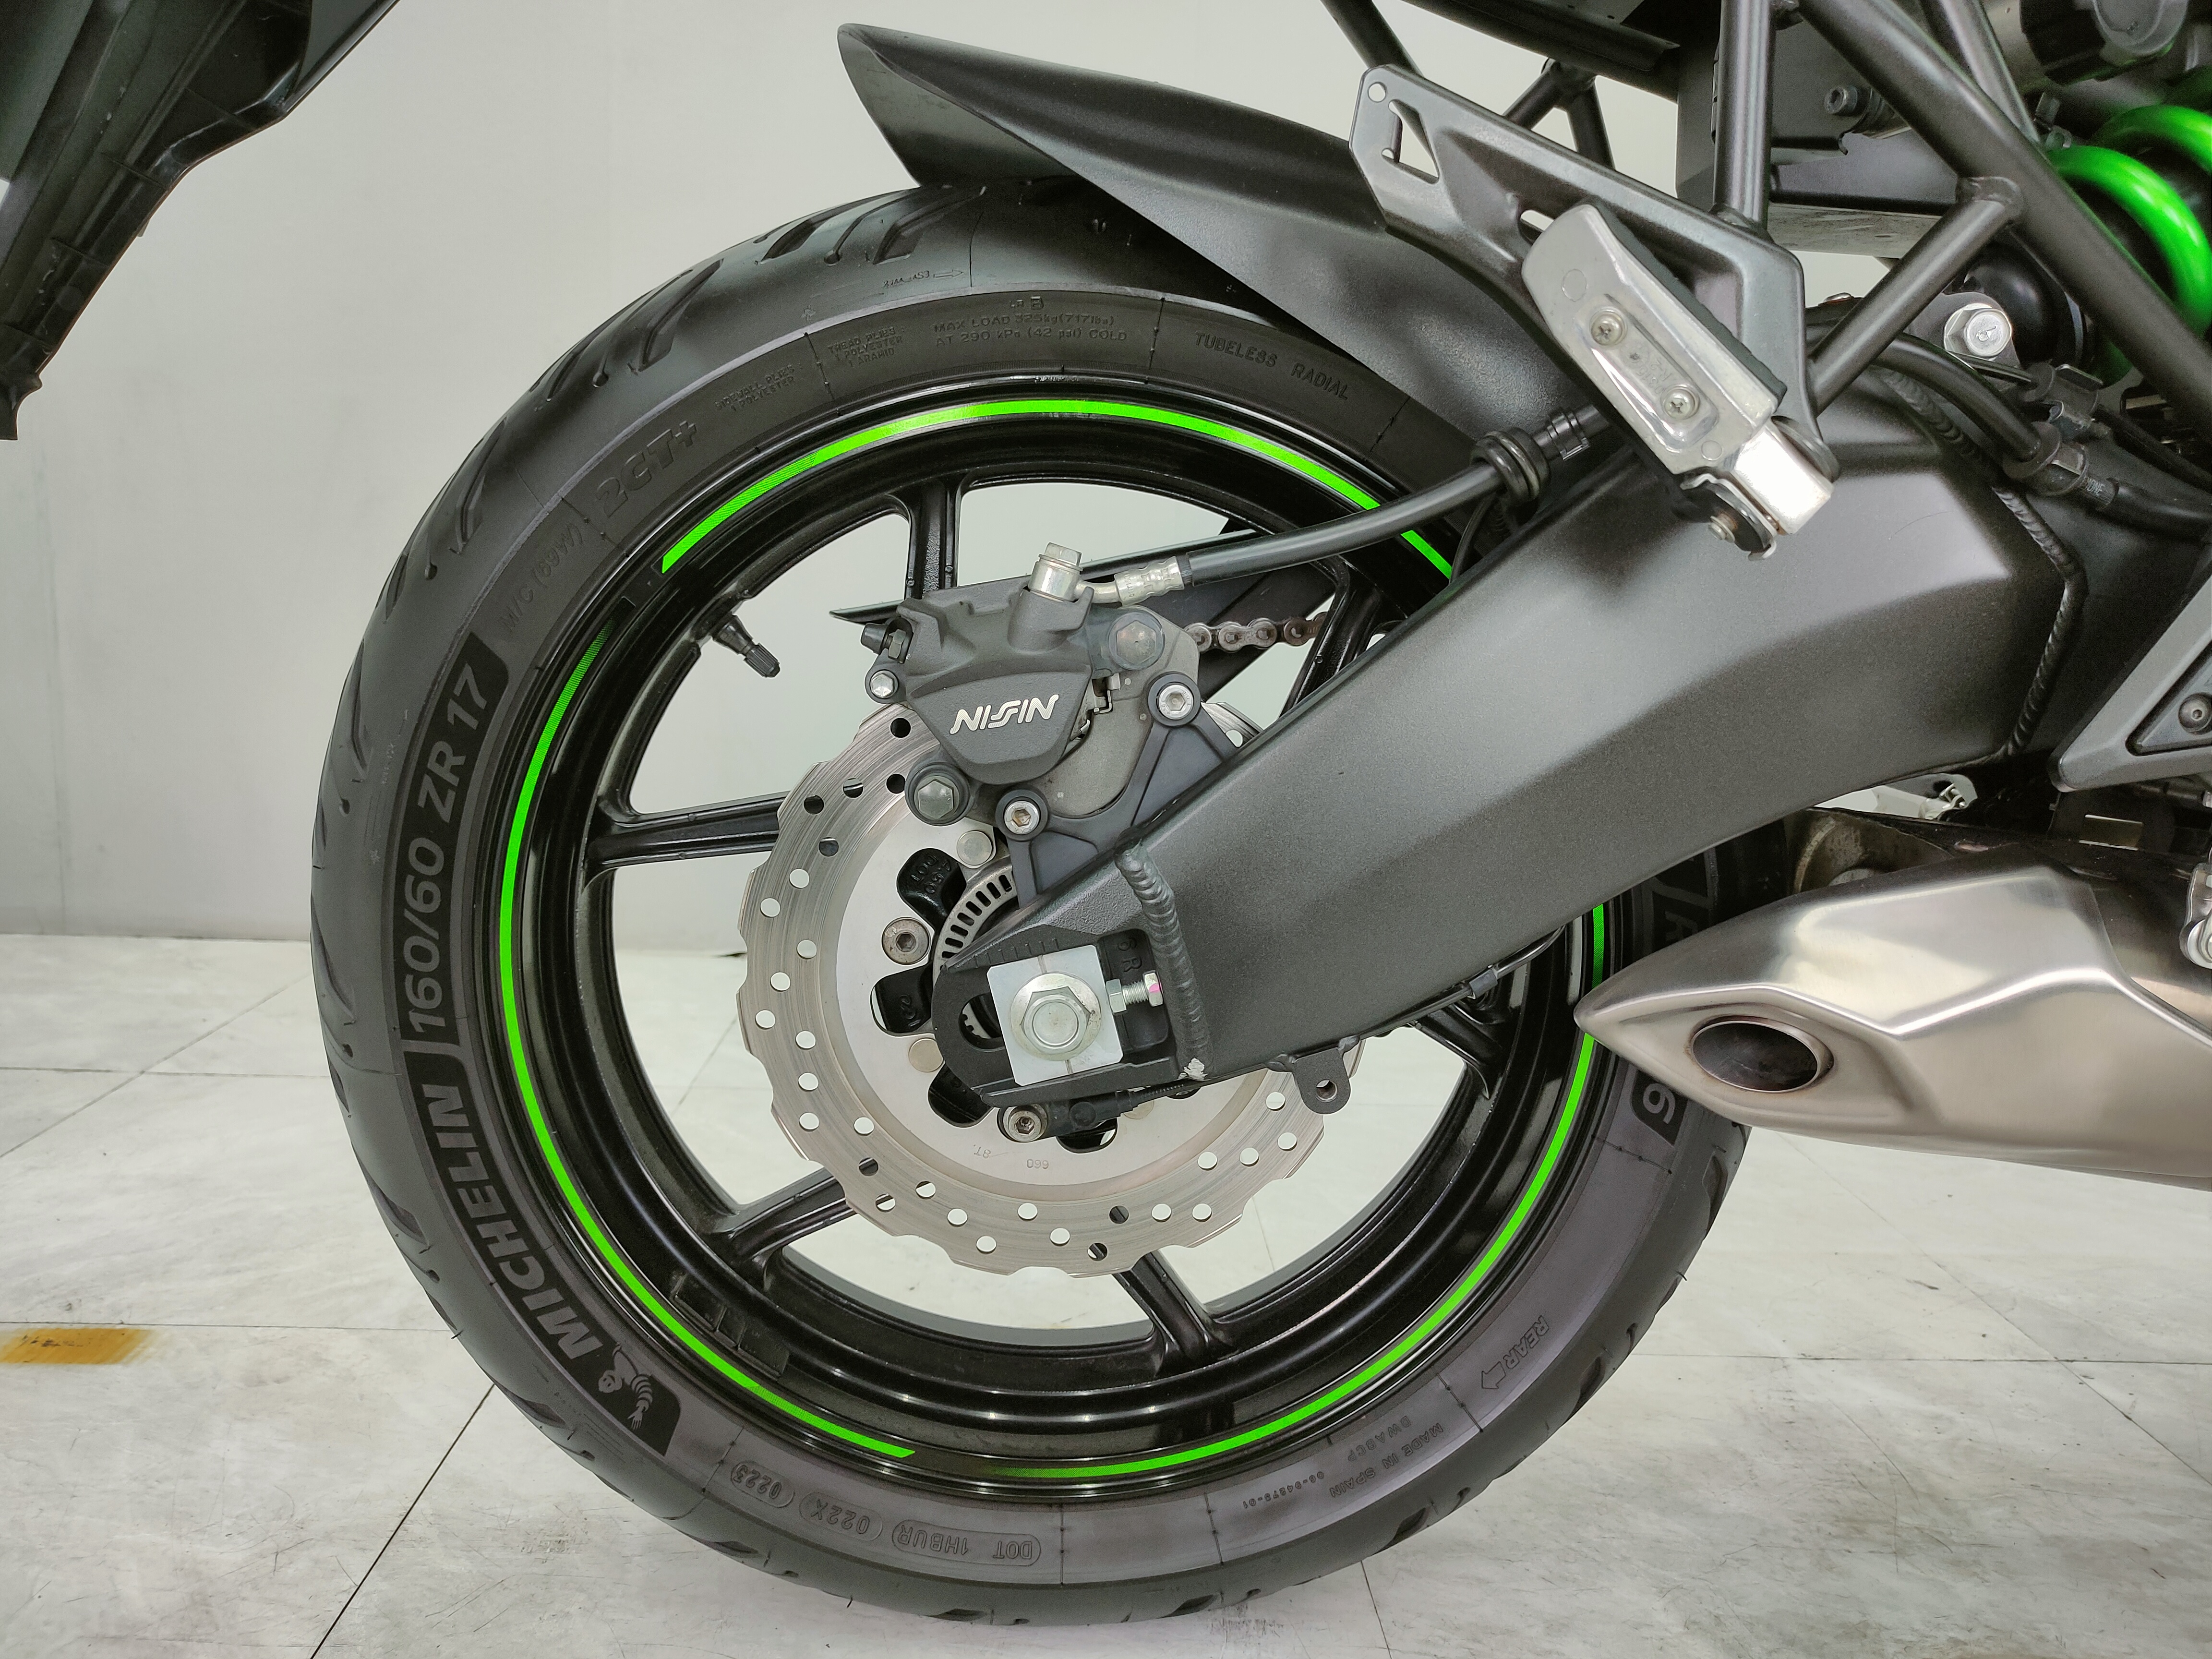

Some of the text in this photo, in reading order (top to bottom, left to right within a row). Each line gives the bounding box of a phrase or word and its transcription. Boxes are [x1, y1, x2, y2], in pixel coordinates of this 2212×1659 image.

[828, 336, 861, 354] TREAD
[934, 319, 965, 333] MAX
[971, 315, 1010, 328] LOAD
[936, 334, 954, 347] AT
[961, 331, 990, 343] 290
[1089, 328, 1127, 341] COLD
[1196, 332, 1348, 400] TUBELESS RADIAL
[596, 421, 697, 518] 2CT+
[447, 662, 487, 731] 17
[417, 741, 467, 823] ZR
[403, 837, 446, 1034] 160/60
[422, 1083, 603, 1359] MICHELIN
[1503, 1315, 1550, 1369] REAR
[734, 1464, 783, 1499] 0223
[1330, 1422, 1444, 1498] MADE IN SPAIN
[811, 1498, 870, 1534] 022X
[898, 1526, 1032, 1560] DOT 1HBUR
